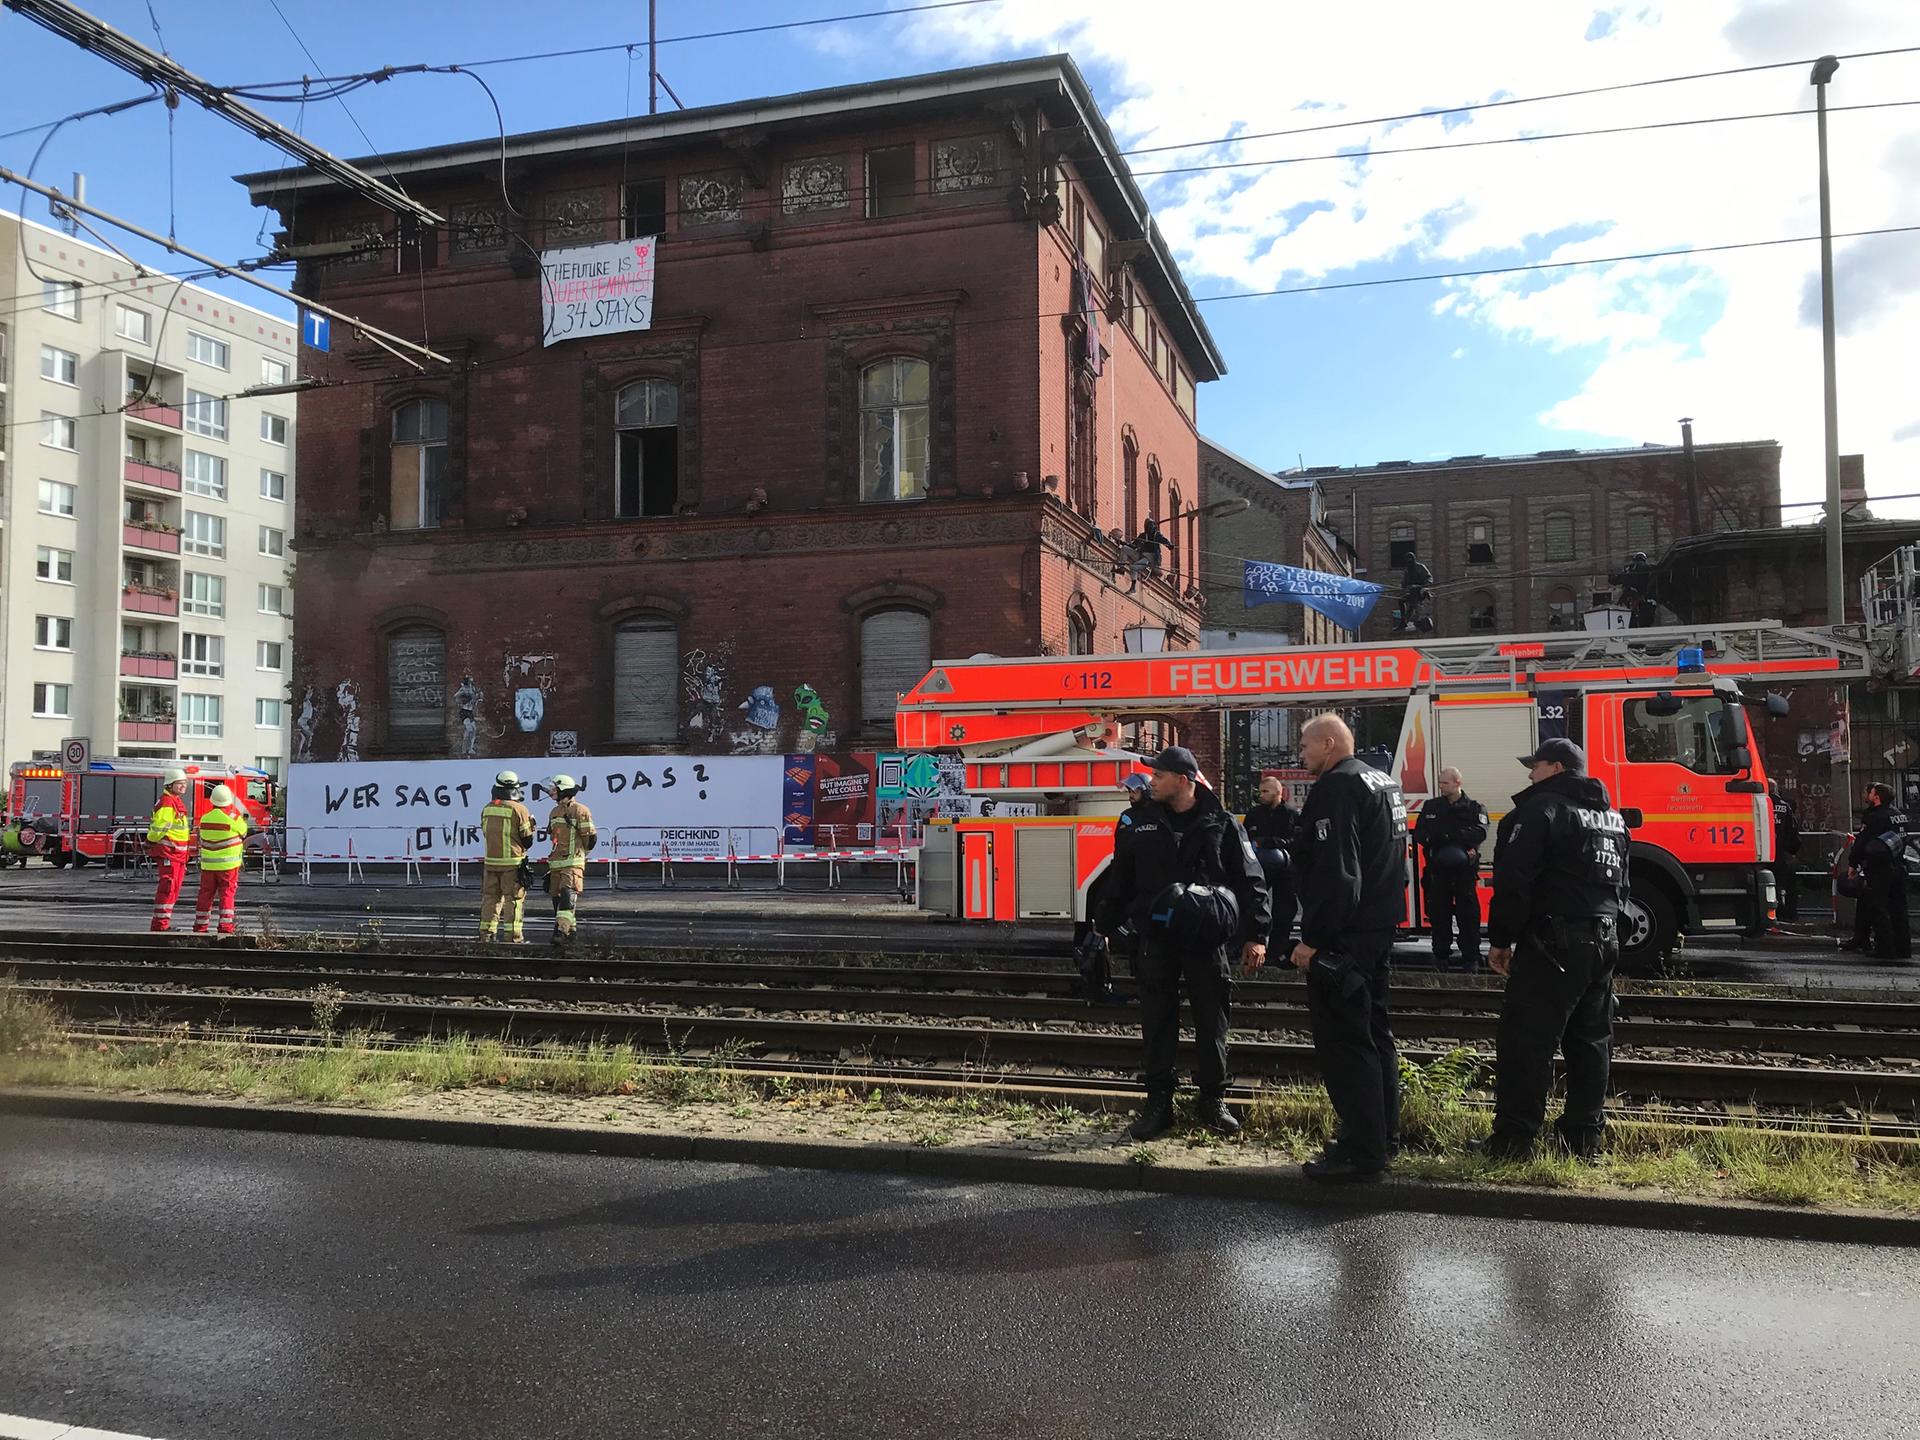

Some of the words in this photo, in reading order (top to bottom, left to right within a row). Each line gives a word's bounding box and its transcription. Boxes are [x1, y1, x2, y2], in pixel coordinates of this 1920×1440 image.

[618, 256, 632, 273] IS
[589, 295, 648, 328] STAYS
[1079, 671, 1113, 690] 112
[1169, 655, 1400, 691] FEUERWEHR
[70, 747, 81, 758] 30
[820, 781, 834, 790] BUT
[834, 778, 863, 788] IMAGINE
[863, 777, 870, 785] IF
[839, 785, 865, 793] COULD.
[325, 782, 380, 815] WER
[395, 783, 472, 808] SAGT
[1577, 808, 1626, 834] POLIZE
[660, 829, 720, 840] DEICHKIND
[1707, 825, 1745, 845] 112
[1603, 837, 1615, 852] BE
